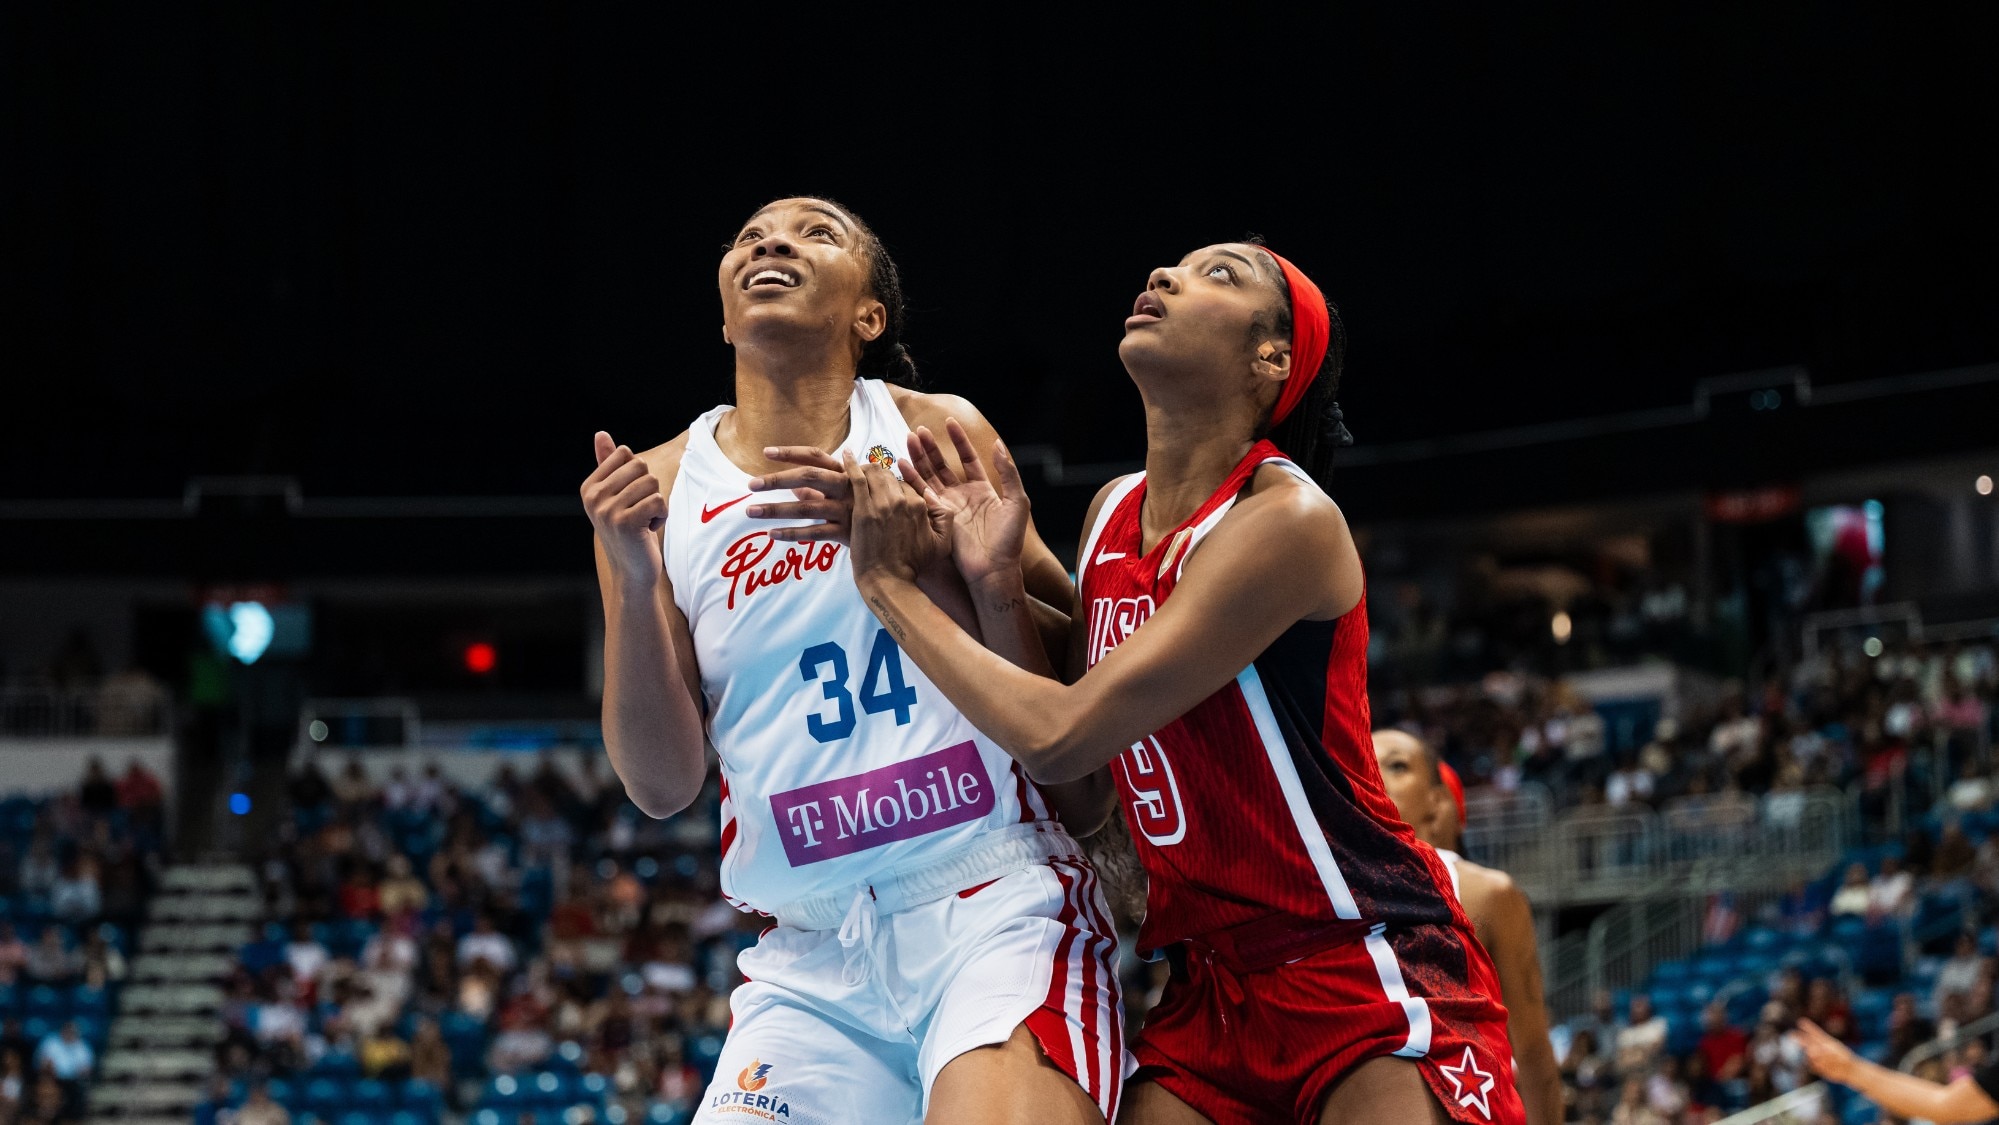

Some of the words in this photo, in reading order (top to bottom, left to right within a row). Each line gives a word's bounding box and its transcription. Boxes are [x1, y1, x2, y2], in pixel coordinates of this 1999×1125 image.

[720, 531, 841, 610] Puerto
[799, 628, 917, 743] 34
[829, 766, 981, 840] Mobile
[712, 1092, 790, 1118] LOTERÍA
[717, 1105, 776, 1121] ELECTRÓNICA
